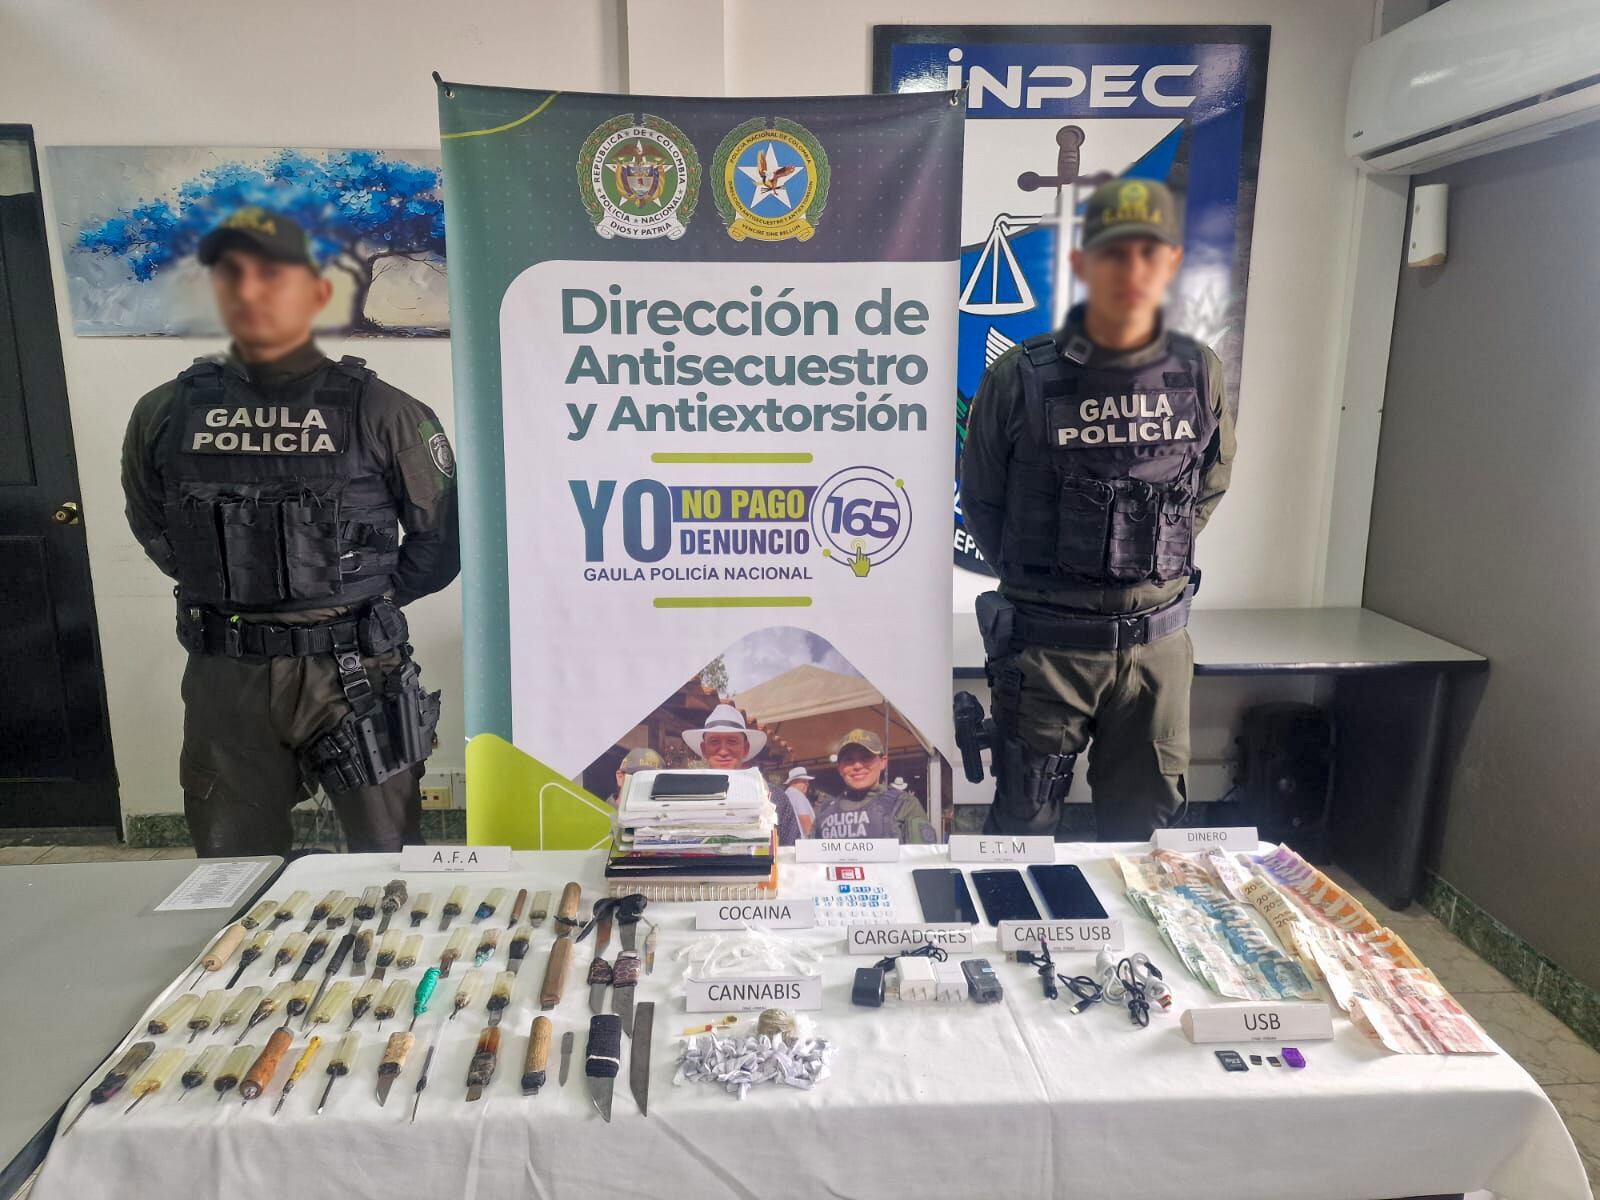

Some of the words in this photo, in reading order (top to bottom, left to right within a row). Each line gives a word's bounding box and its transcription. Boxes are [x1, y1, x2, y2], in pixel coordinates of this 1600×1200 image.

[593, 133, 623, 183] REPUBLICA
[633, 129, 646, 137] DE
[656, 135, 686, 185] COLOMBIA
[599, 194, 630, 222] POLICIA
[641, 195, 682, 224] NACIONAL
[610, 221, 631, 234] DIOS
[633, 228, 639, 236] Y
[641, 222, 672, 236] PATRIA
[561, 283, 839, 337] Dirección
[854, 287, 930, 337] de
[565, 340, 929, 386] Antisecuestro
[204, 406, 327, 430] GAULA
[566, 402, 598, 442] y
[607, 391, 928, 433] Antiextorsión
[1079, 393, 1174, 423] GAULA
[191, 428, 337, 453] POLICÍA
[1057, 416, 1197, 446] POLICÍA
[681, 489, 722, 519] NO
[731, 488, 806, 519] PAGO
[568, 478, 673, 563] YO
[826, 495, 899, 540] 165
[679, 529, 810, 556] DENUNCIO
[583, 567, 646, 582] GAULA
[650, 564, 720, 581] POLICÍA
[723, 566, 813, 581] NACIONAL
[822, 823, 868, 839] GAULA
[1186, 831, 1228, 842] DINERO
[821, 842, 841, 852] SIM
[844, 842, 874, 852] CARD
[719, 905, 792, 921] COCAINA
[854, 929, 967, 945] CARGADORES
[1079, 926, 1112, 942] USB
[708, 983, 801, 1002] CANNABIS
[1243, 1012, 1281, 1031] USB
